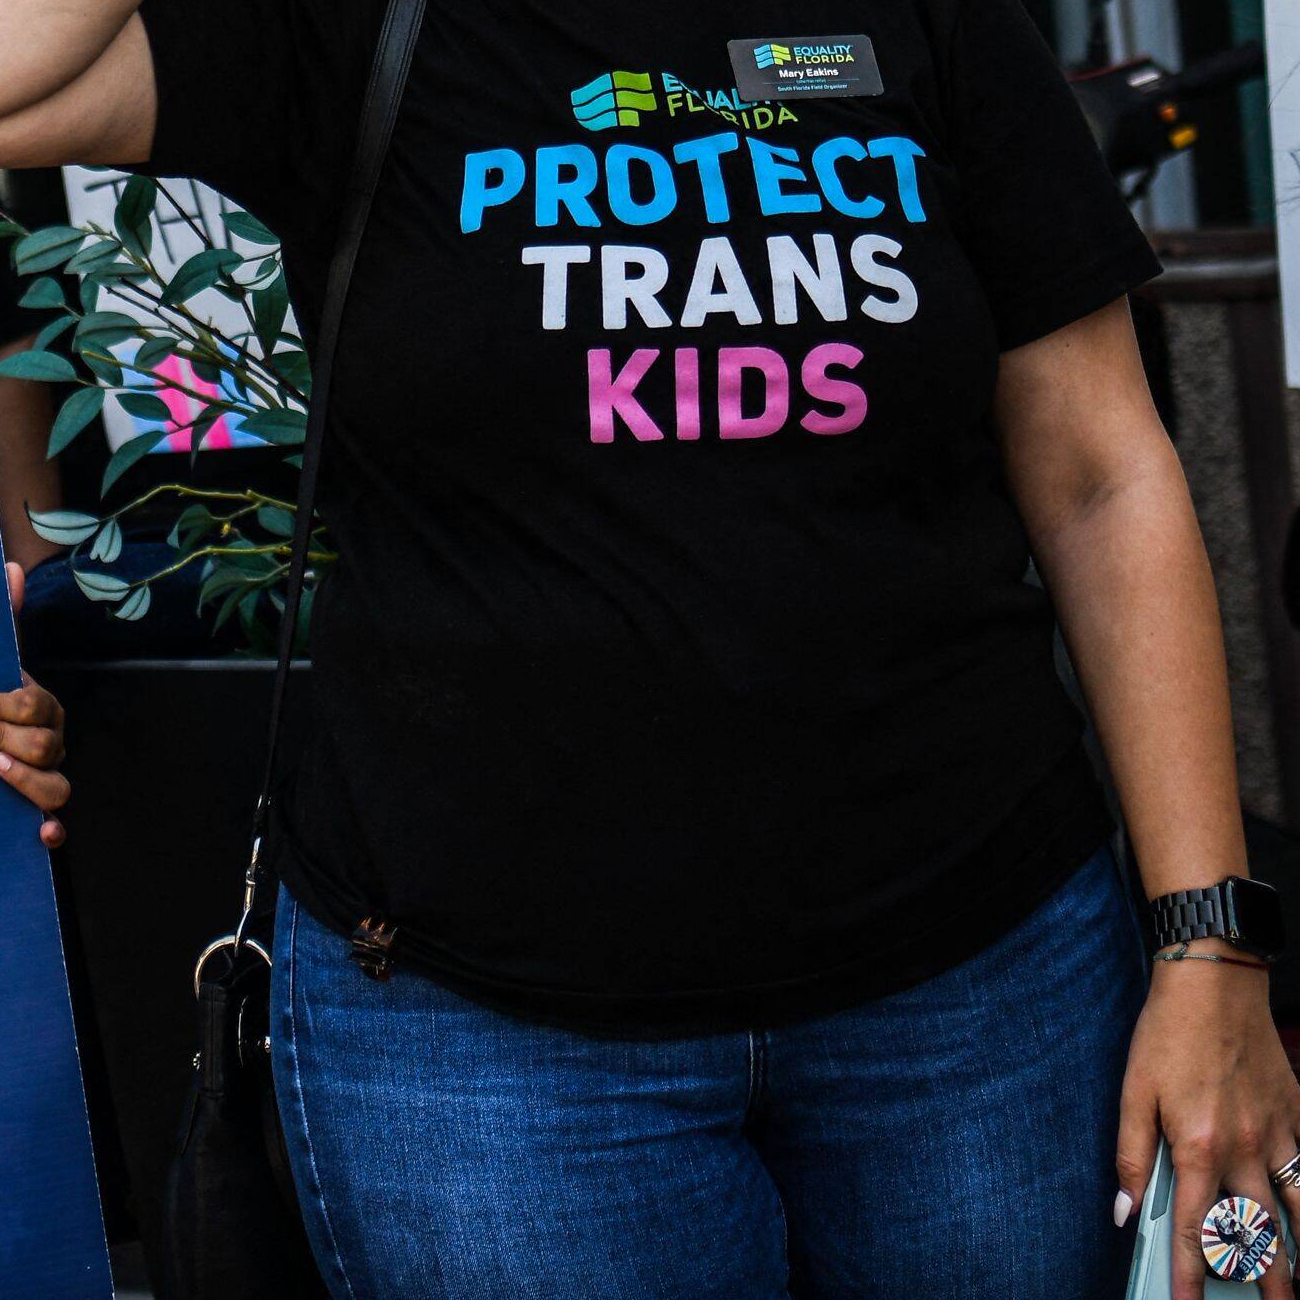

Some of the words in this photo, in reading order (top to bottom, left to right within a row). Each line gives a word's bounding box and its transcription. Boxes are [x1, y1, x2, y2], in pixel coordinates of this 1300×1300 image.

[793, 45, 851, 56] EQUALITY
[796, 54, 855, 65] FLORIDA
[779, 69, 804, 79] Mary
[806, 67, 839, 78] Eakins
[824, 83, 848, 91] Organizer
[459, 132, 928, 234] PROTECT
[521, 233, 919, 330] TRANS
[586, 342, 868, 444] KIDS
[1242, 1230, 1273, 1271] DOOD
